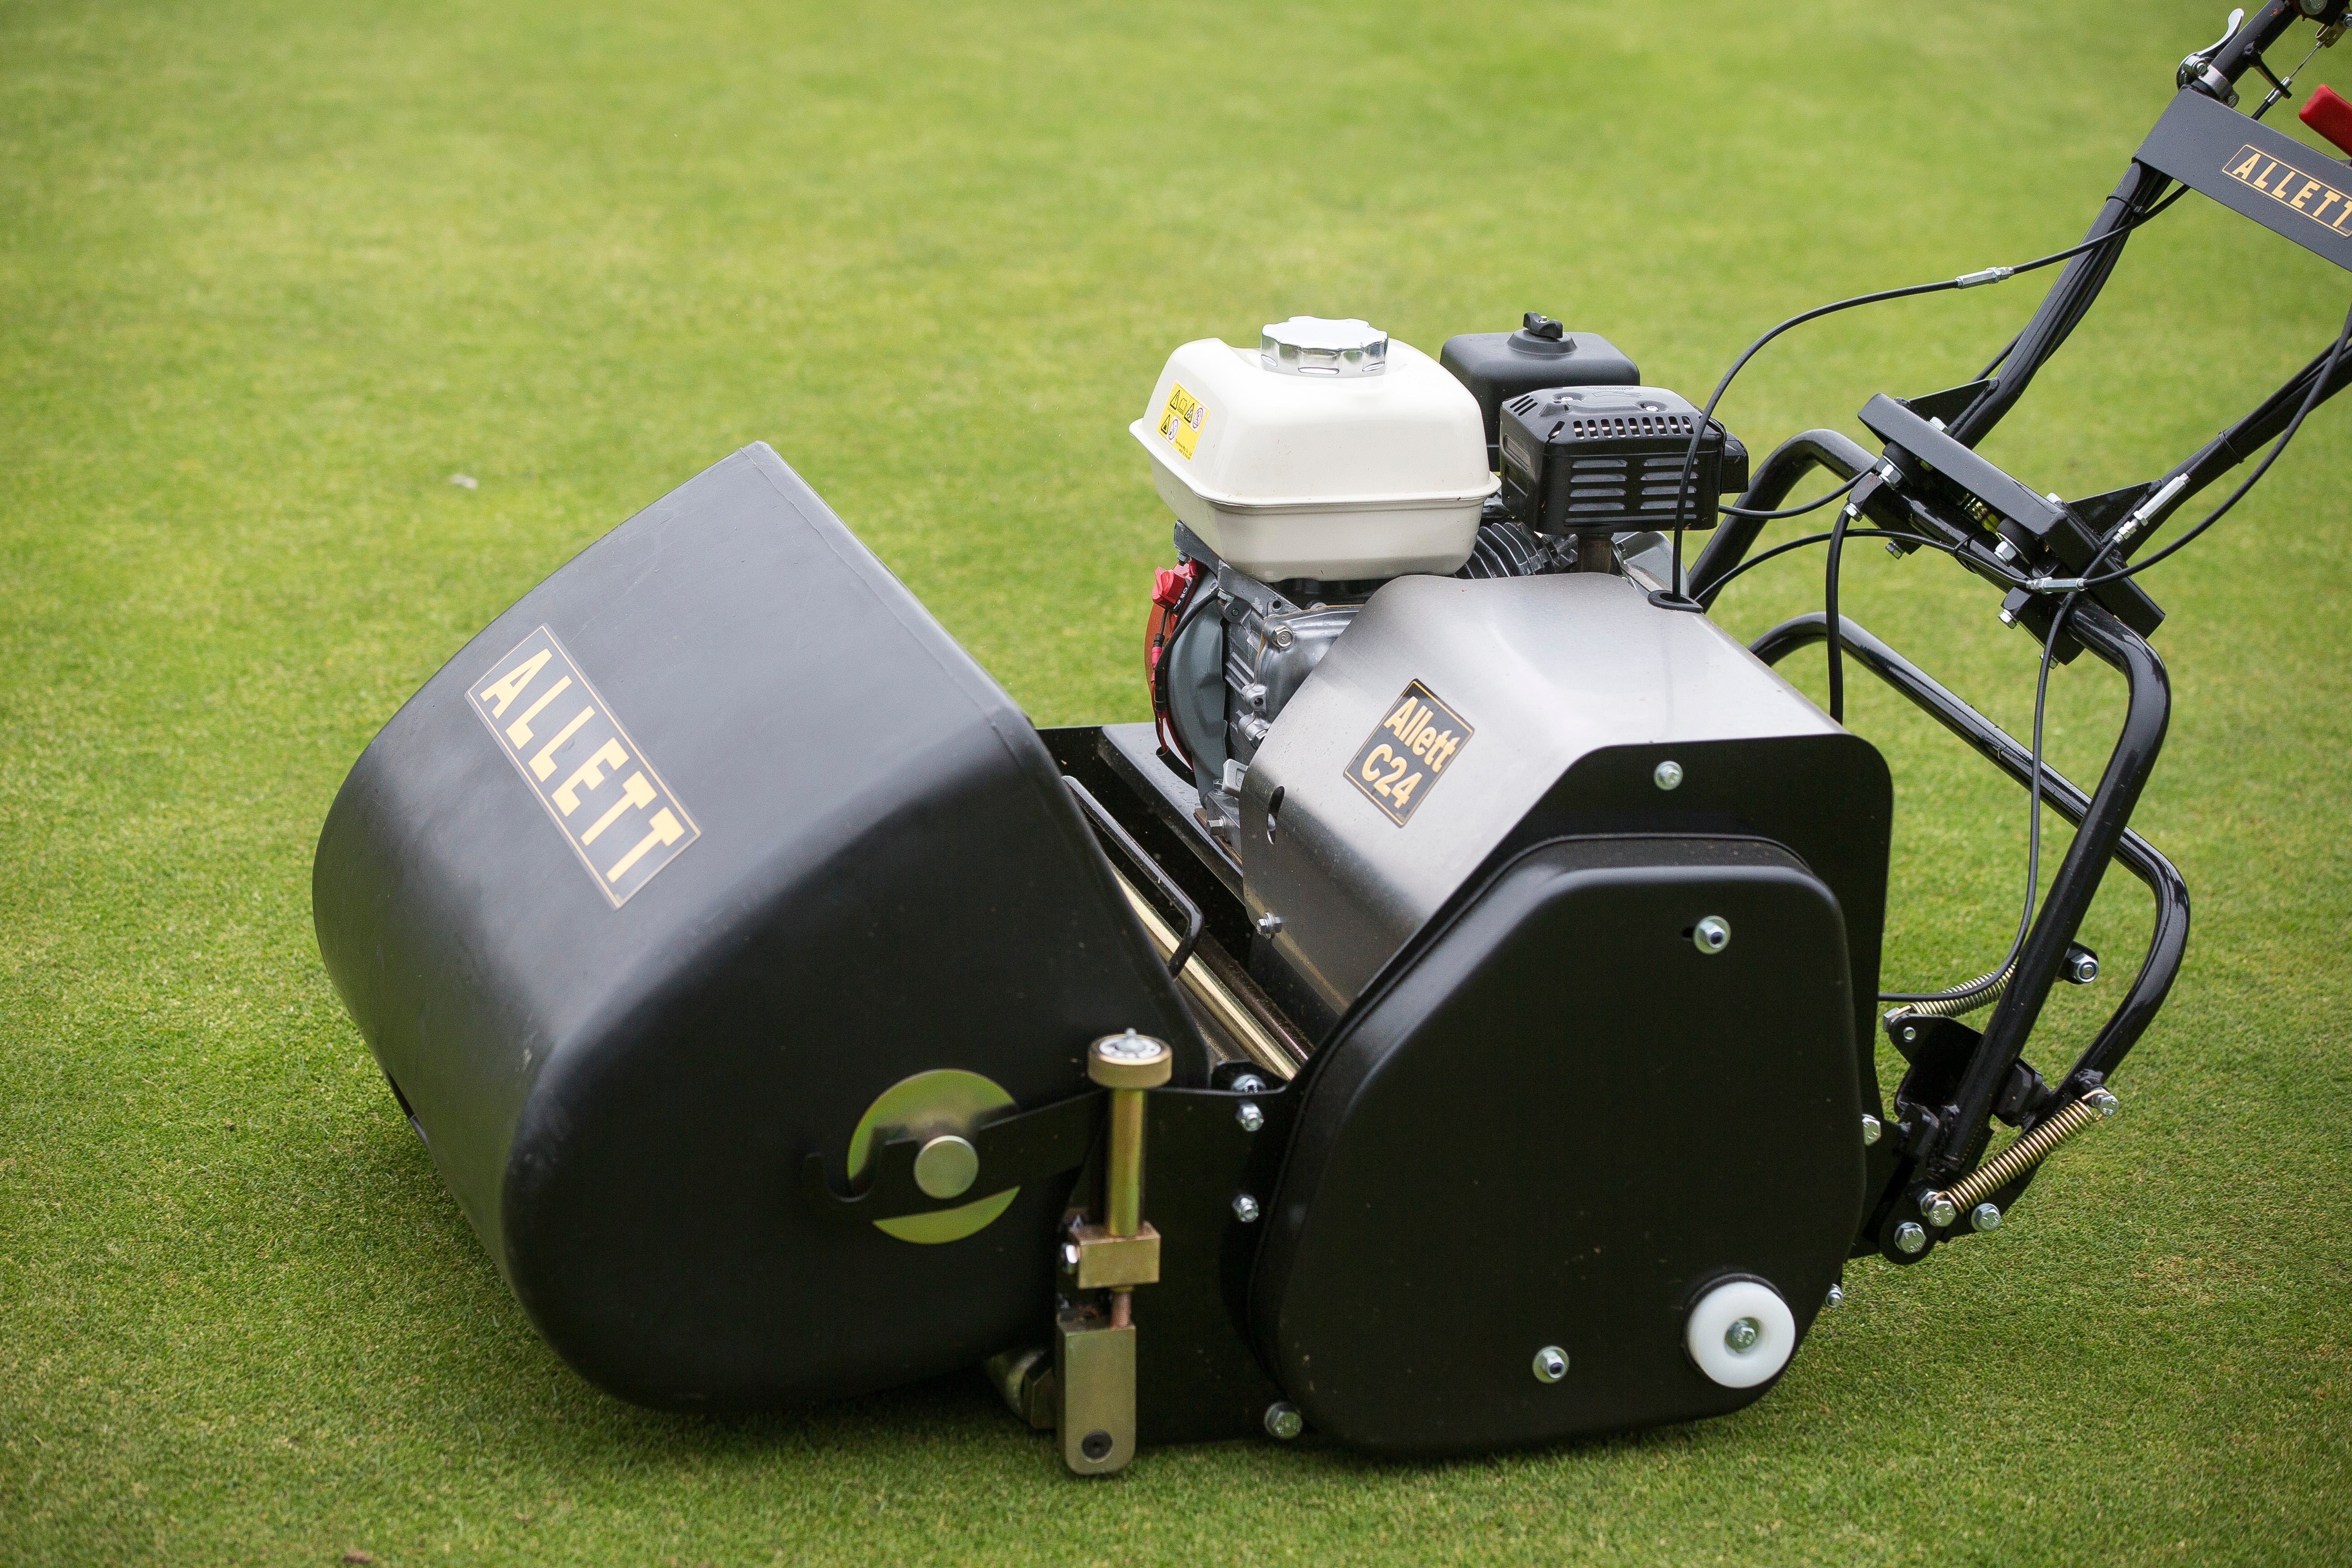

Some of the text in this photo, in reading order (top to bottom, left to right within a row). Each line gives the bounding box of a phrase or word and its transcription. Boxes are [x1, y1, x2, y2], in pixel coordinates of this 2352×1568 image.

[2232, 153, 2352, 228] ALLETT
[480, 648, 685, 883] ALLETT
[1384, 696, 1460, 772] Allett
[1362, 744, 1423, 809] C24
